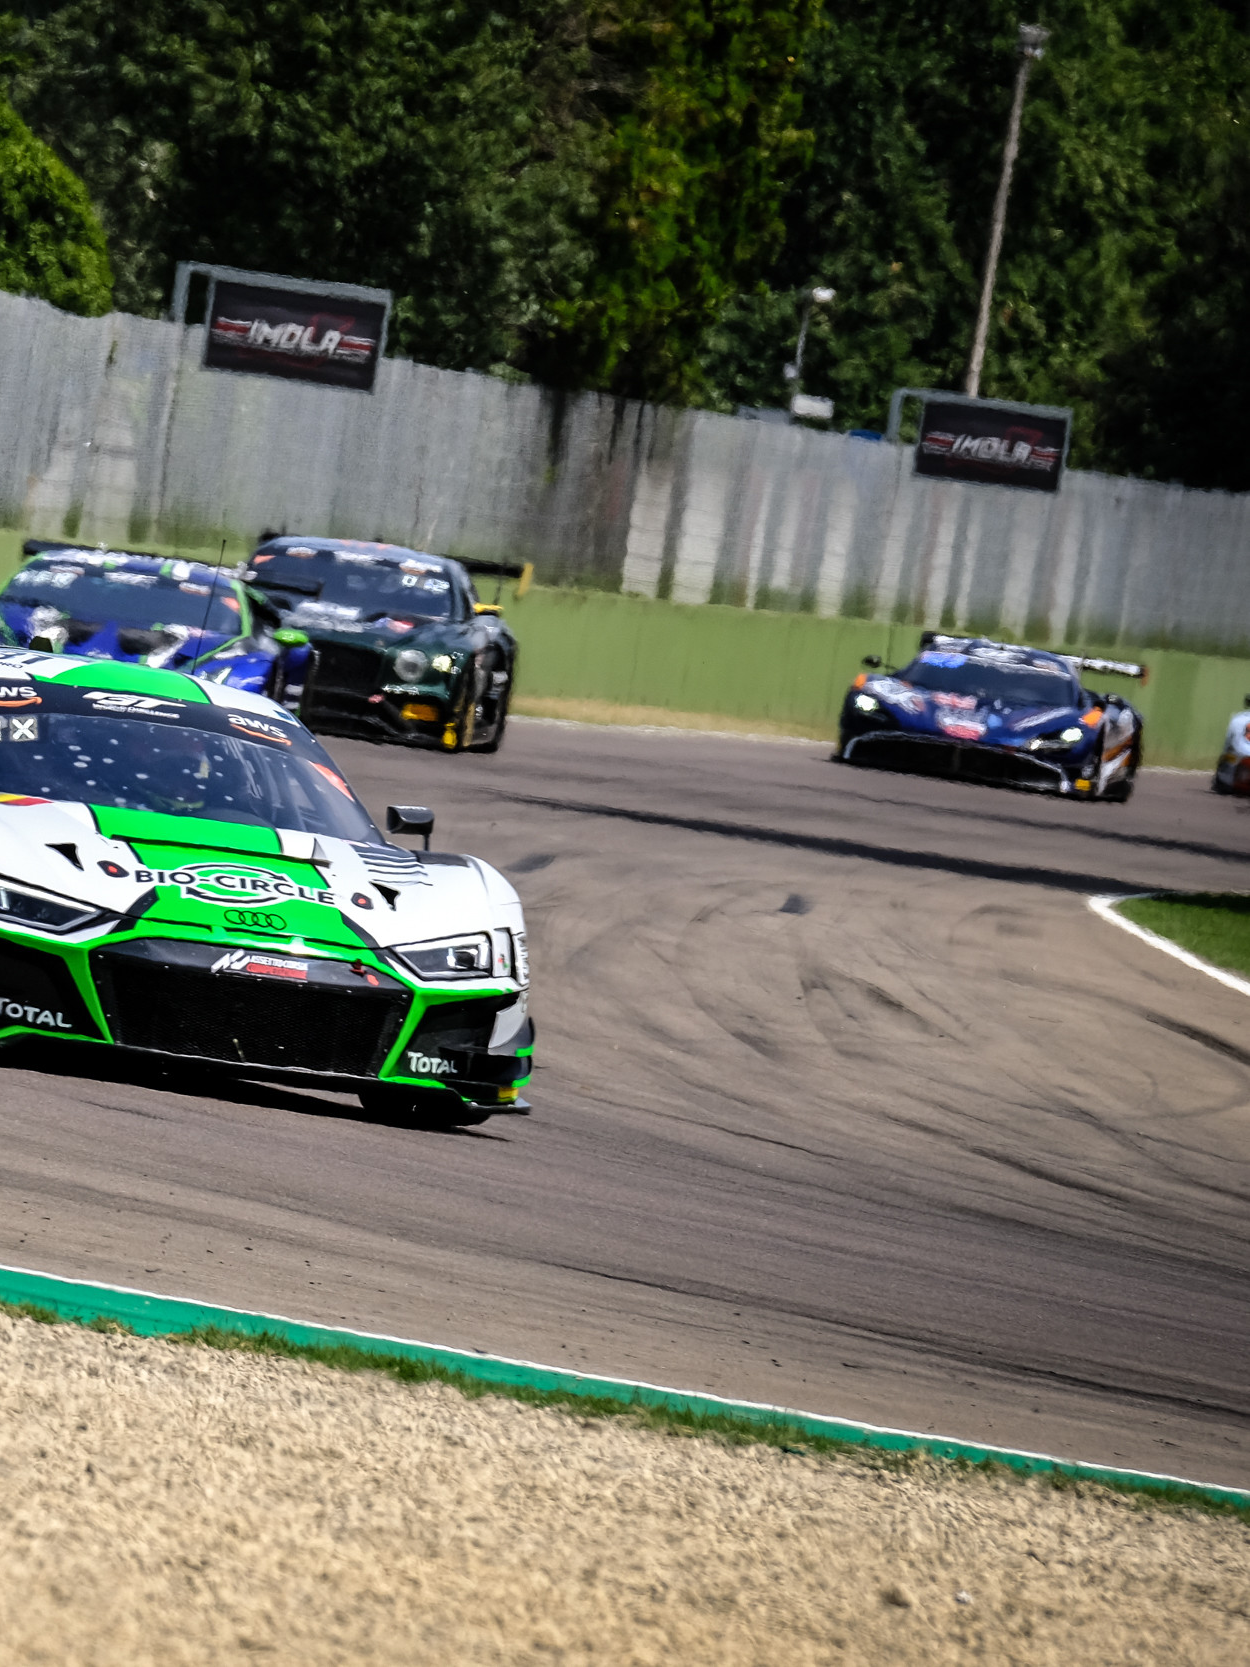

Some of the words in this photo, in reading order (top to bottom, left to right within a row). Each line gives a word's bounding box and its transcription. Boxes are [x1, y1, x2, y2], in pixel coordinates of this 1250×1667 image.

[248, 318, 342, 356] IMOLA
[950, 433, 1032, 464] IMOLA
[227, 714, 288, 738] aws
[135, 869, 335, 904] BIO-CIRCLE
[408, 1052, 458, 1074] TOTAL
